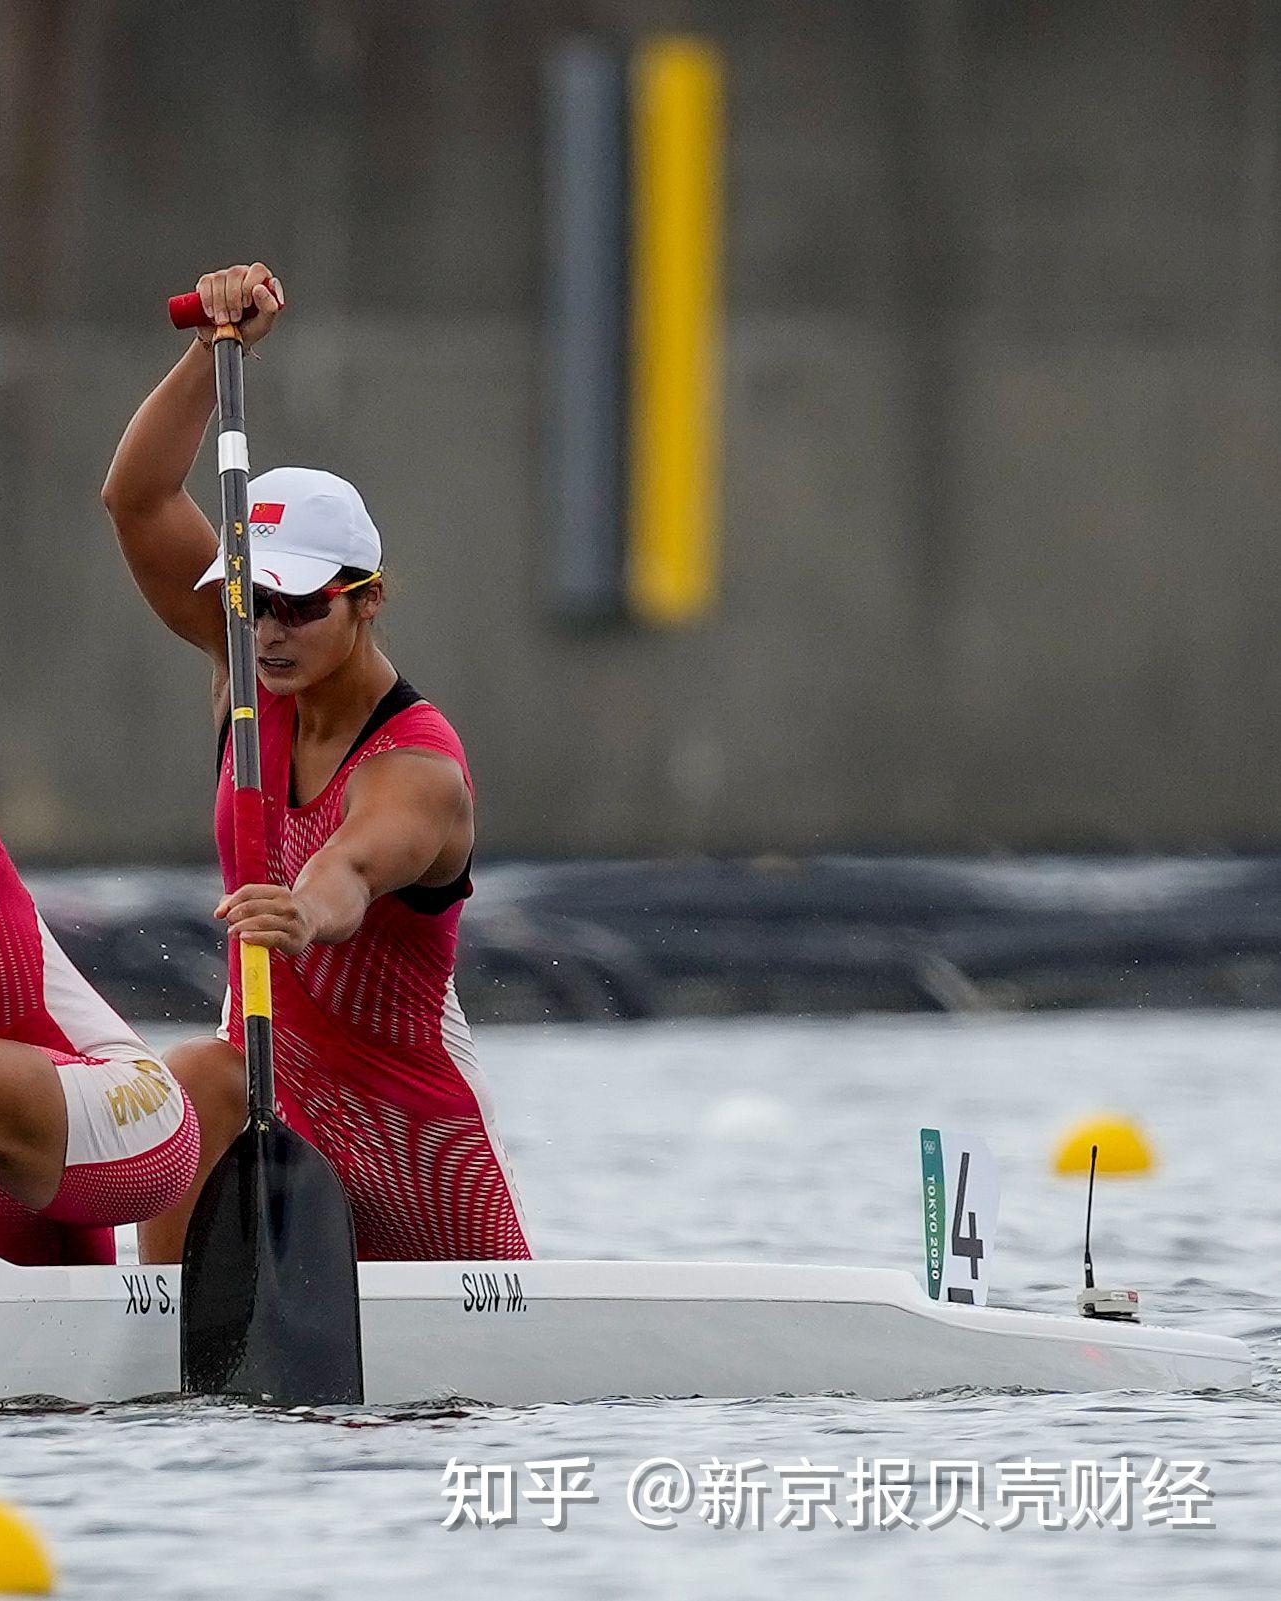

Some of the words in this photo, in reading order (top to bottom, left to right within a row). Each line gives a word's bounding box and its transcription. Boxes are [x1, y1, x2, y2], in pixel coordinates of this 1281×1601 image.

[926, 1174, 939, 1234] TOKYO
[951, 1152, 984, 1280] 4
[930, 1237, 940, 1280] 2020
[122, 1274, 151, 1315] XU
[156, 1274, 175, 1315] S.
[462, 1272, 500, 1313] SUN
[504, 1272, 527, 1313] M.
